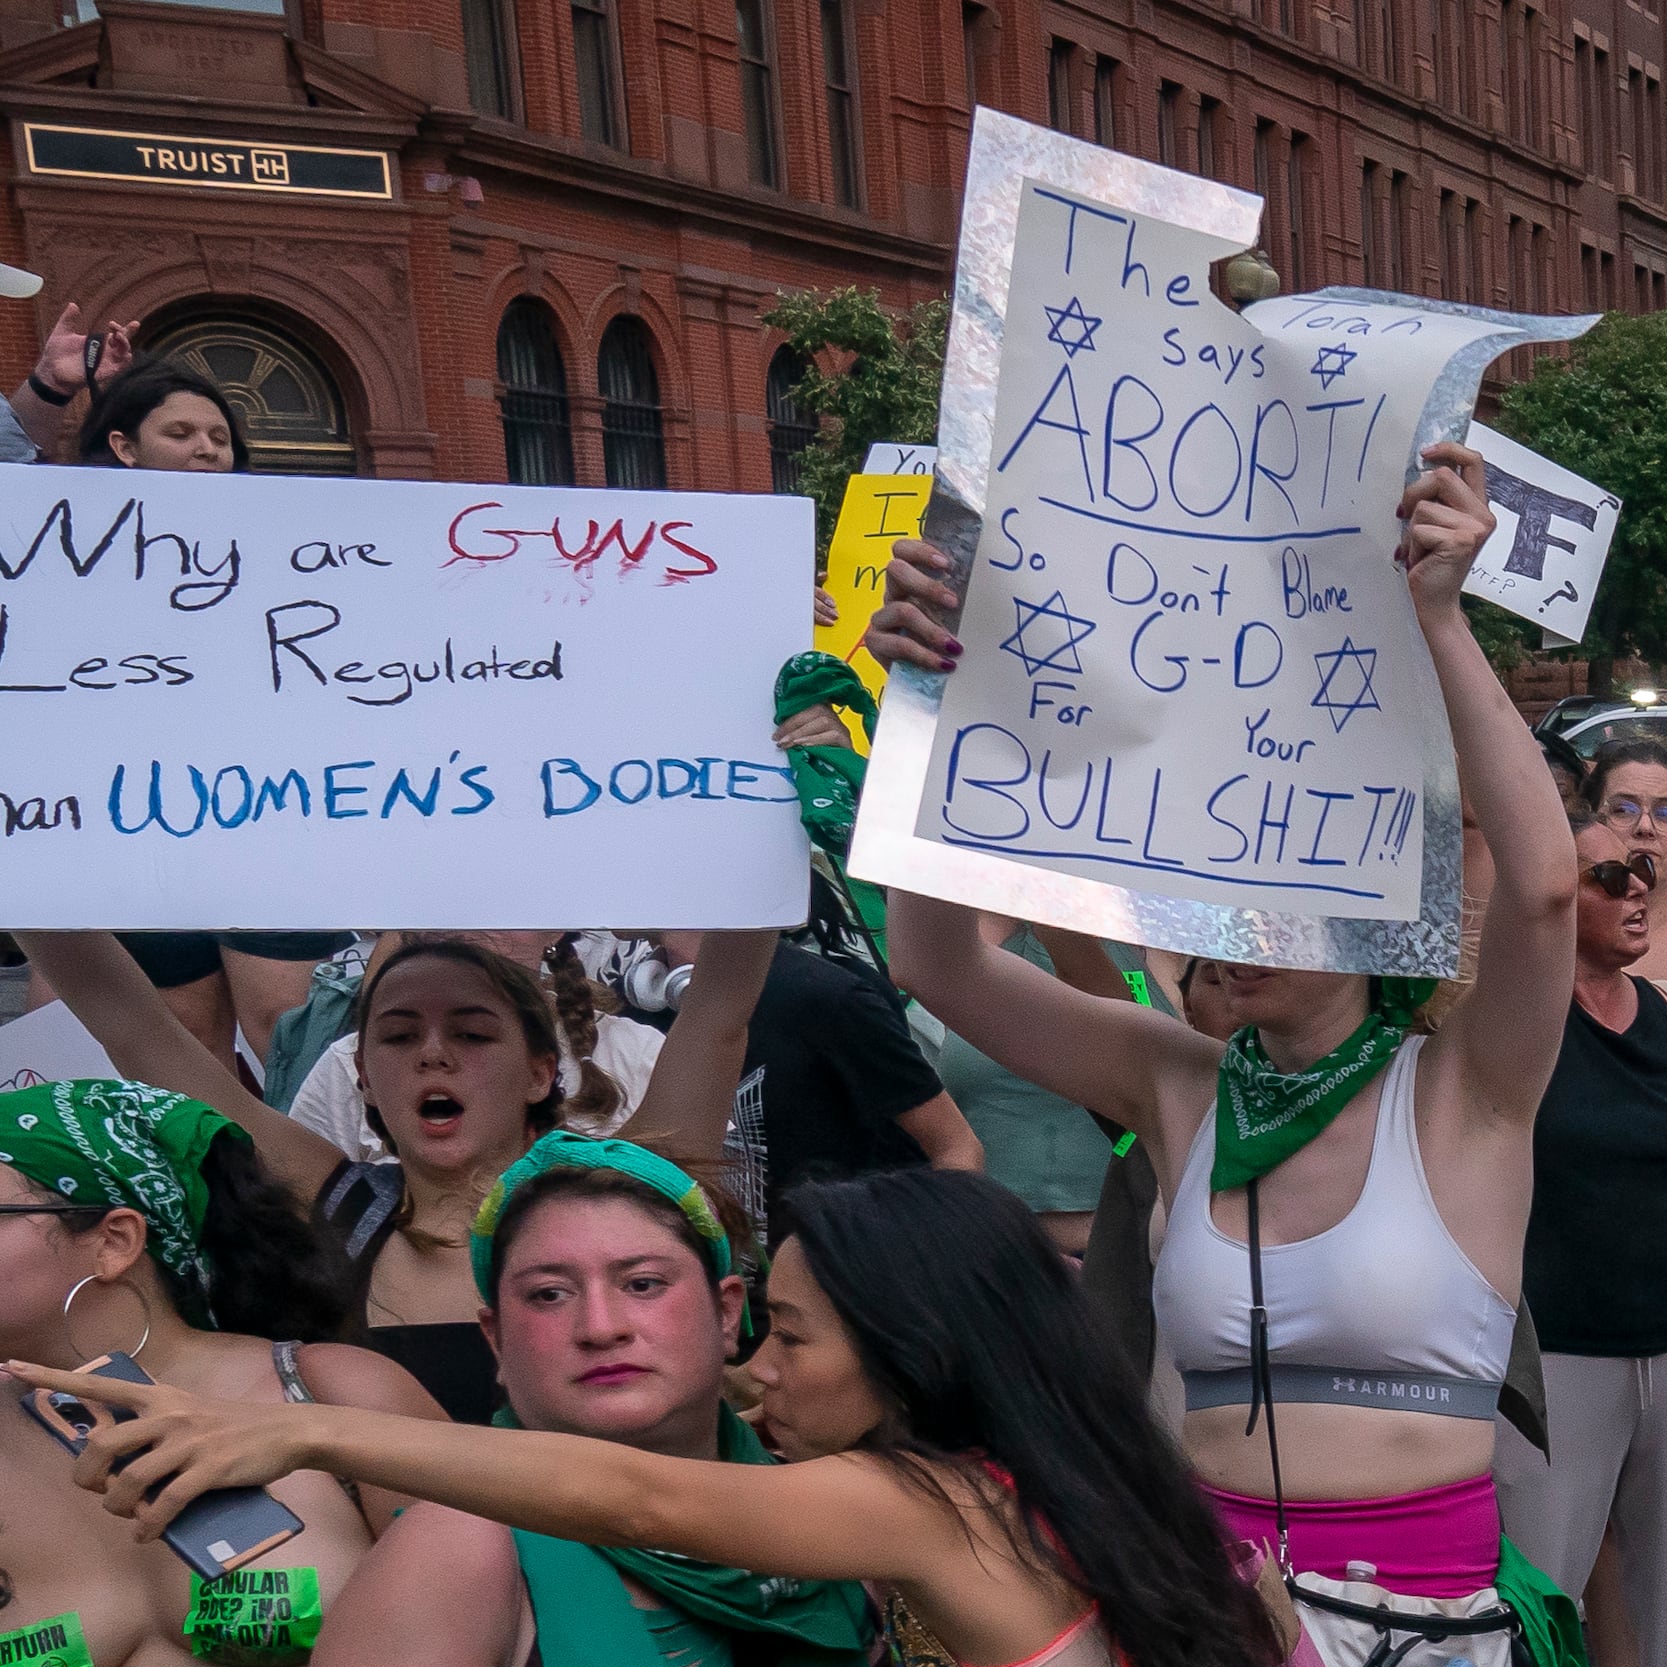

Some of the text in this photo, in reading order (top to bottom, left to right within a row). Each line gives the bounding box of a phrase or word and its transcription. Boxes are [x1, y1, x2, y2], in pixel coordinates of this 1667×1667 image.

[136, 147, 245, 175] TRUIST
[1033, 188, 1425, 338] The Torah
[1162, 328, 1267, 384] says
[999, 364, 1386, 523] ABORT!
[0, 498, 718, 611] Why are GUNS
[988, 508, 1046, 573] So
[1106, 543, 1229, 617] Don't
[1280, 547, 1353, 617] Blame
[0, 600, 564, 706] Less Regulated
[1129, 612, 1284, 692] G-D
[1031, 682, 1317, 766] For Your
[108, 749, 496, 838] WOMEN'S
[1360, 1381, 1450, 1403] ARMOUR
